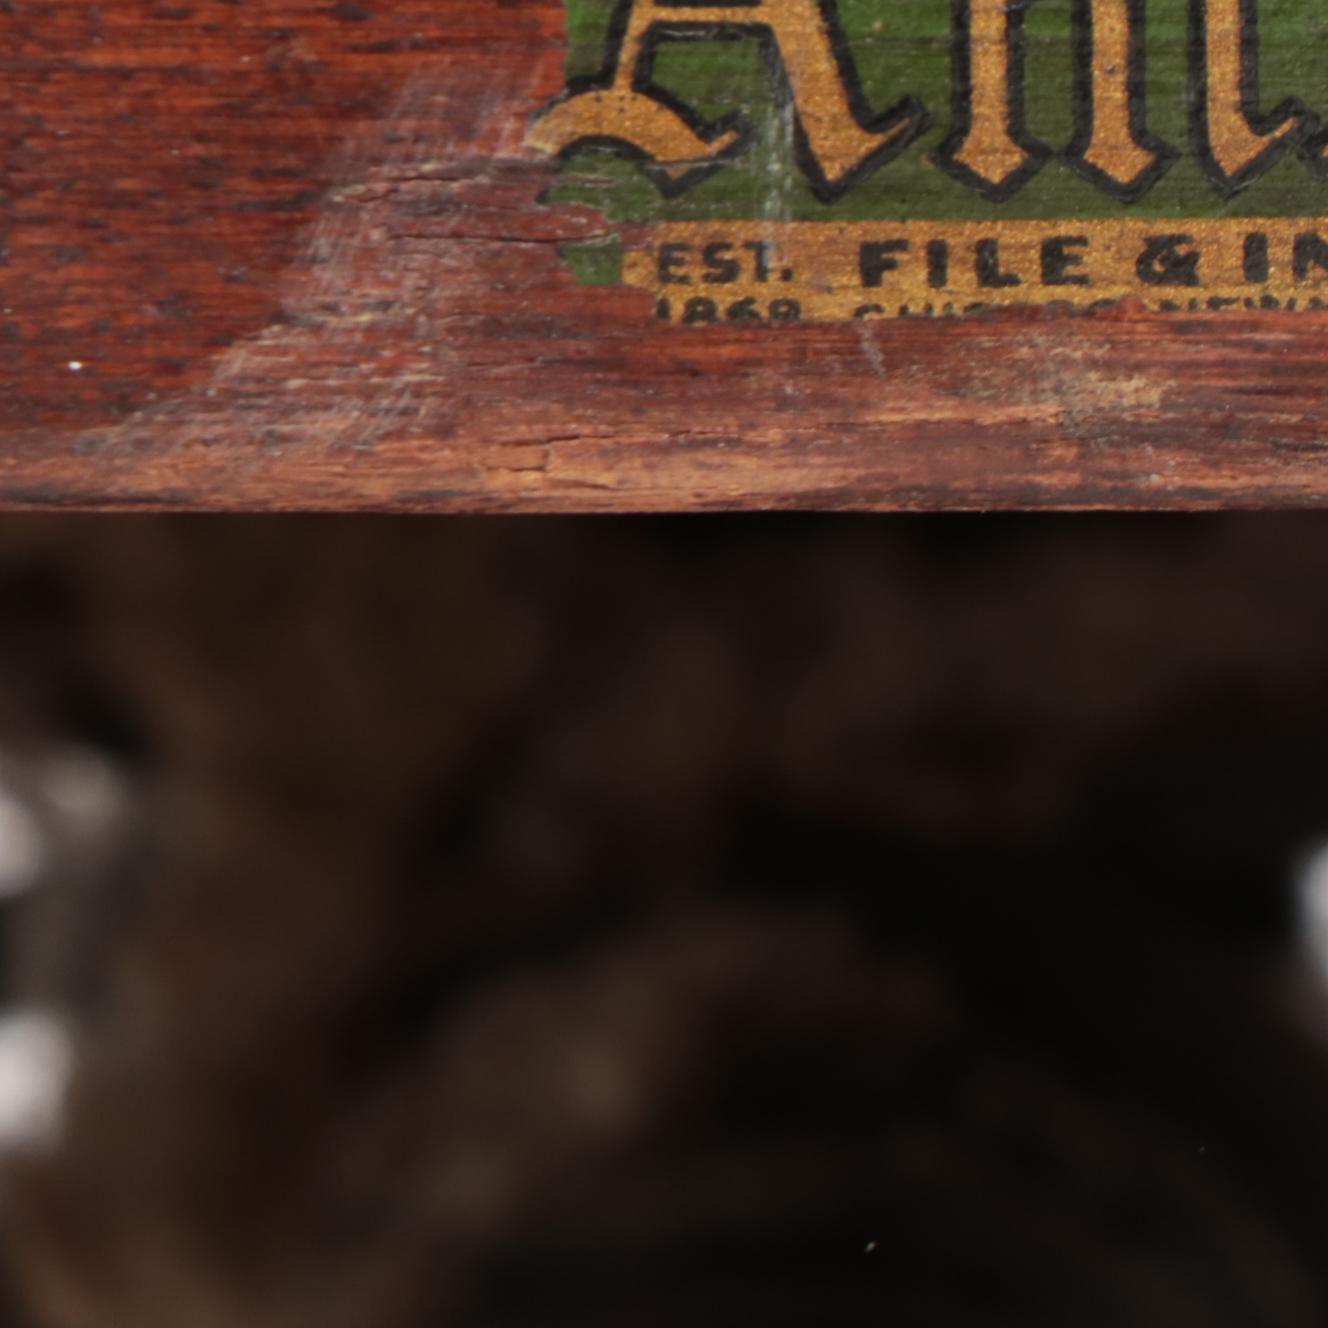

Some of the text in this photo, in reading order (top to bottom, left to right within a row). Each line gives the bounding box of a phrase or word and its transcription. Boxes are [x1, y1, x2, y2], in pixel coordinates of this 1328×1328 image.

[656, 240, 794, 285] EST.
[858, 235, 1090, 289] FILE
[1135, 232, 1201, 287] &
